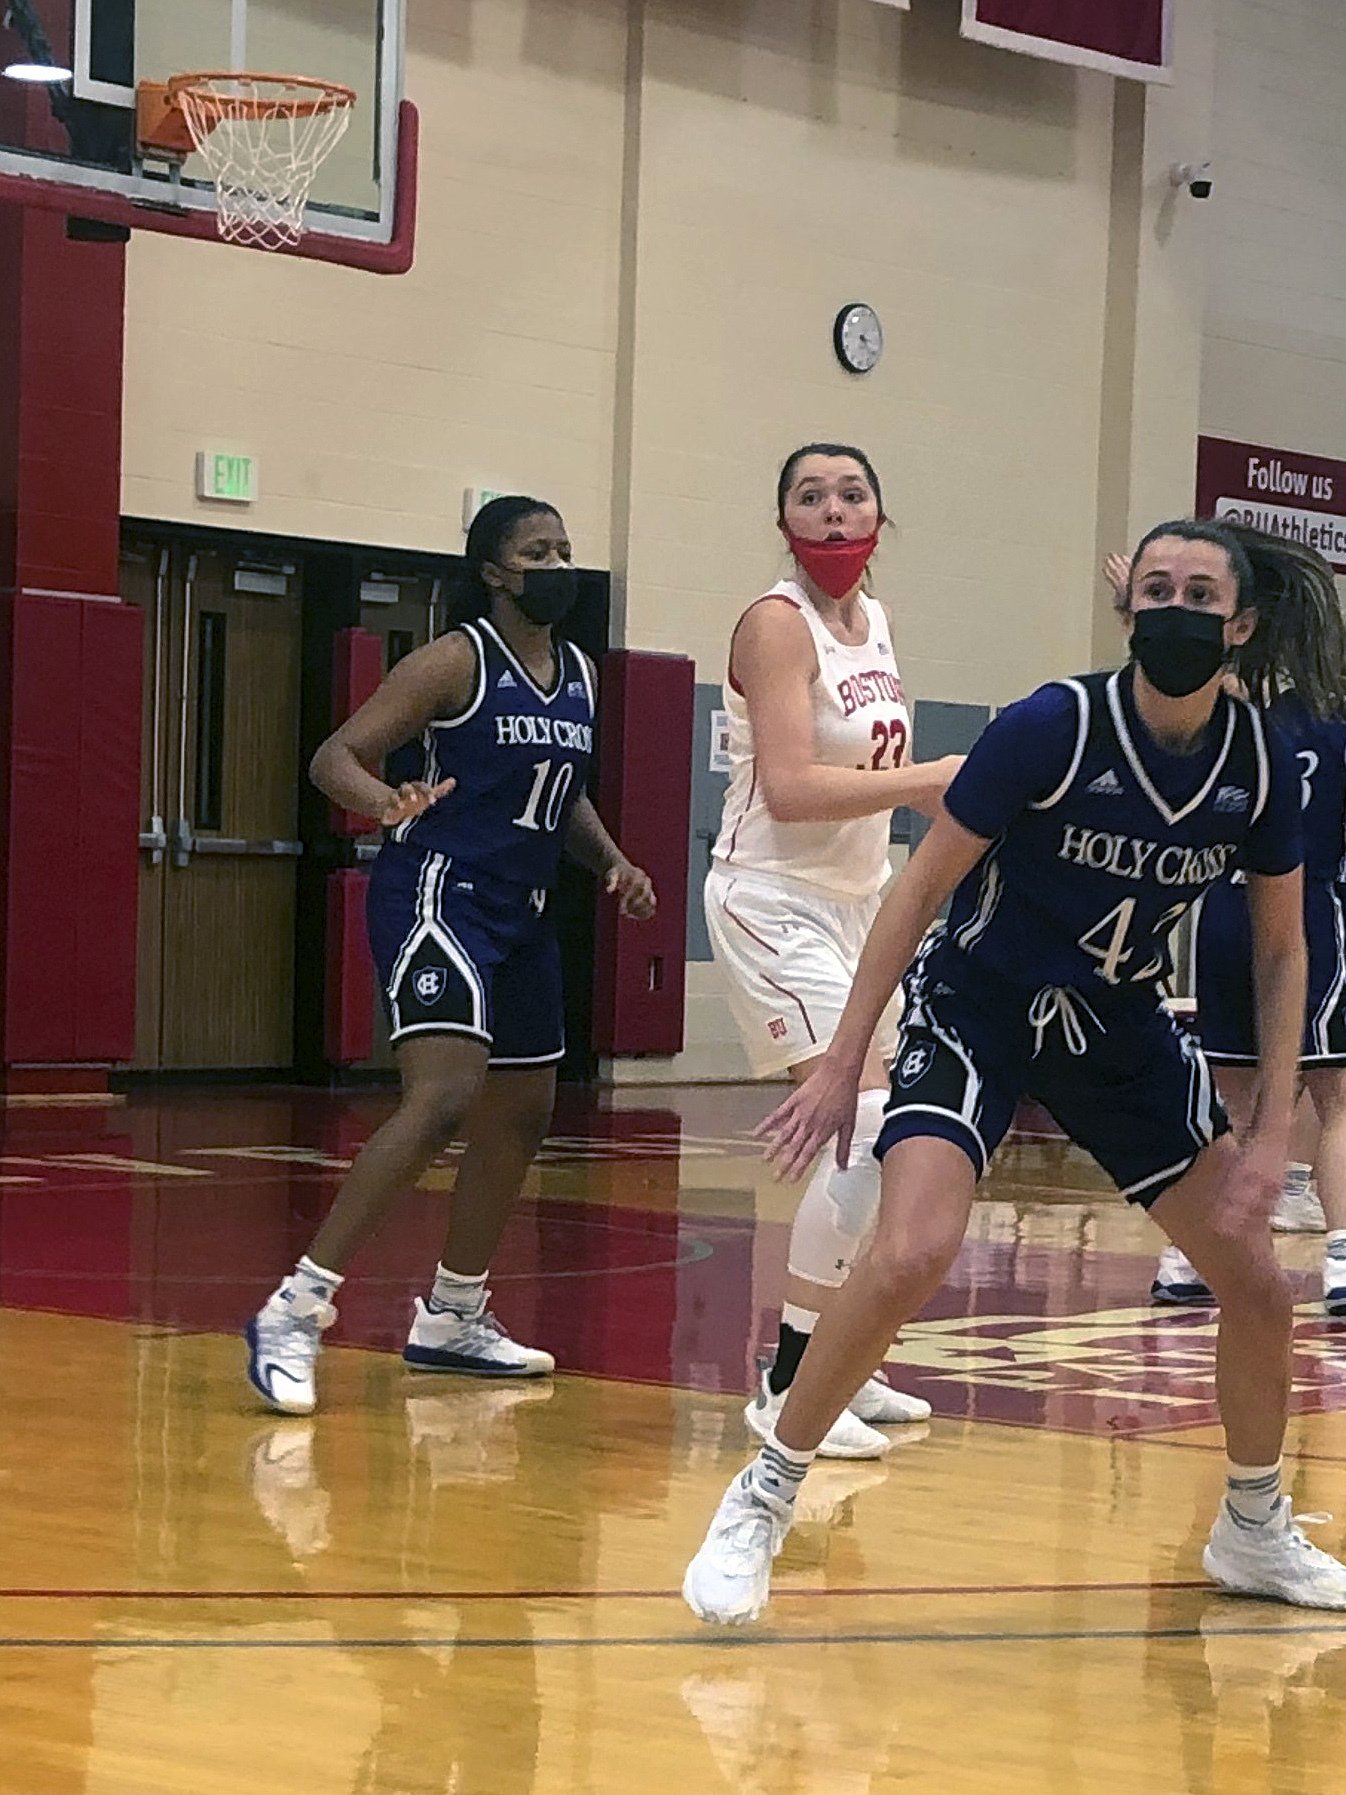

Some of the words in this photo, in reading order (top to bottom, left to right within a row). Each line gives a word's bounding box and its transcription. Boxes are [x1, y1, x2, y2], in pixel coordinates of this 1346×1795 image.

[214, 454, 252, 496] EXIT
[1247, 457, 1308, 497] Follow
[1313, 476, 1334, 501] us
[495, 715, 552, 745] HOLY
[512, 758, 573, 832] 10
[1057, 823, 1158, 880] HOLY
